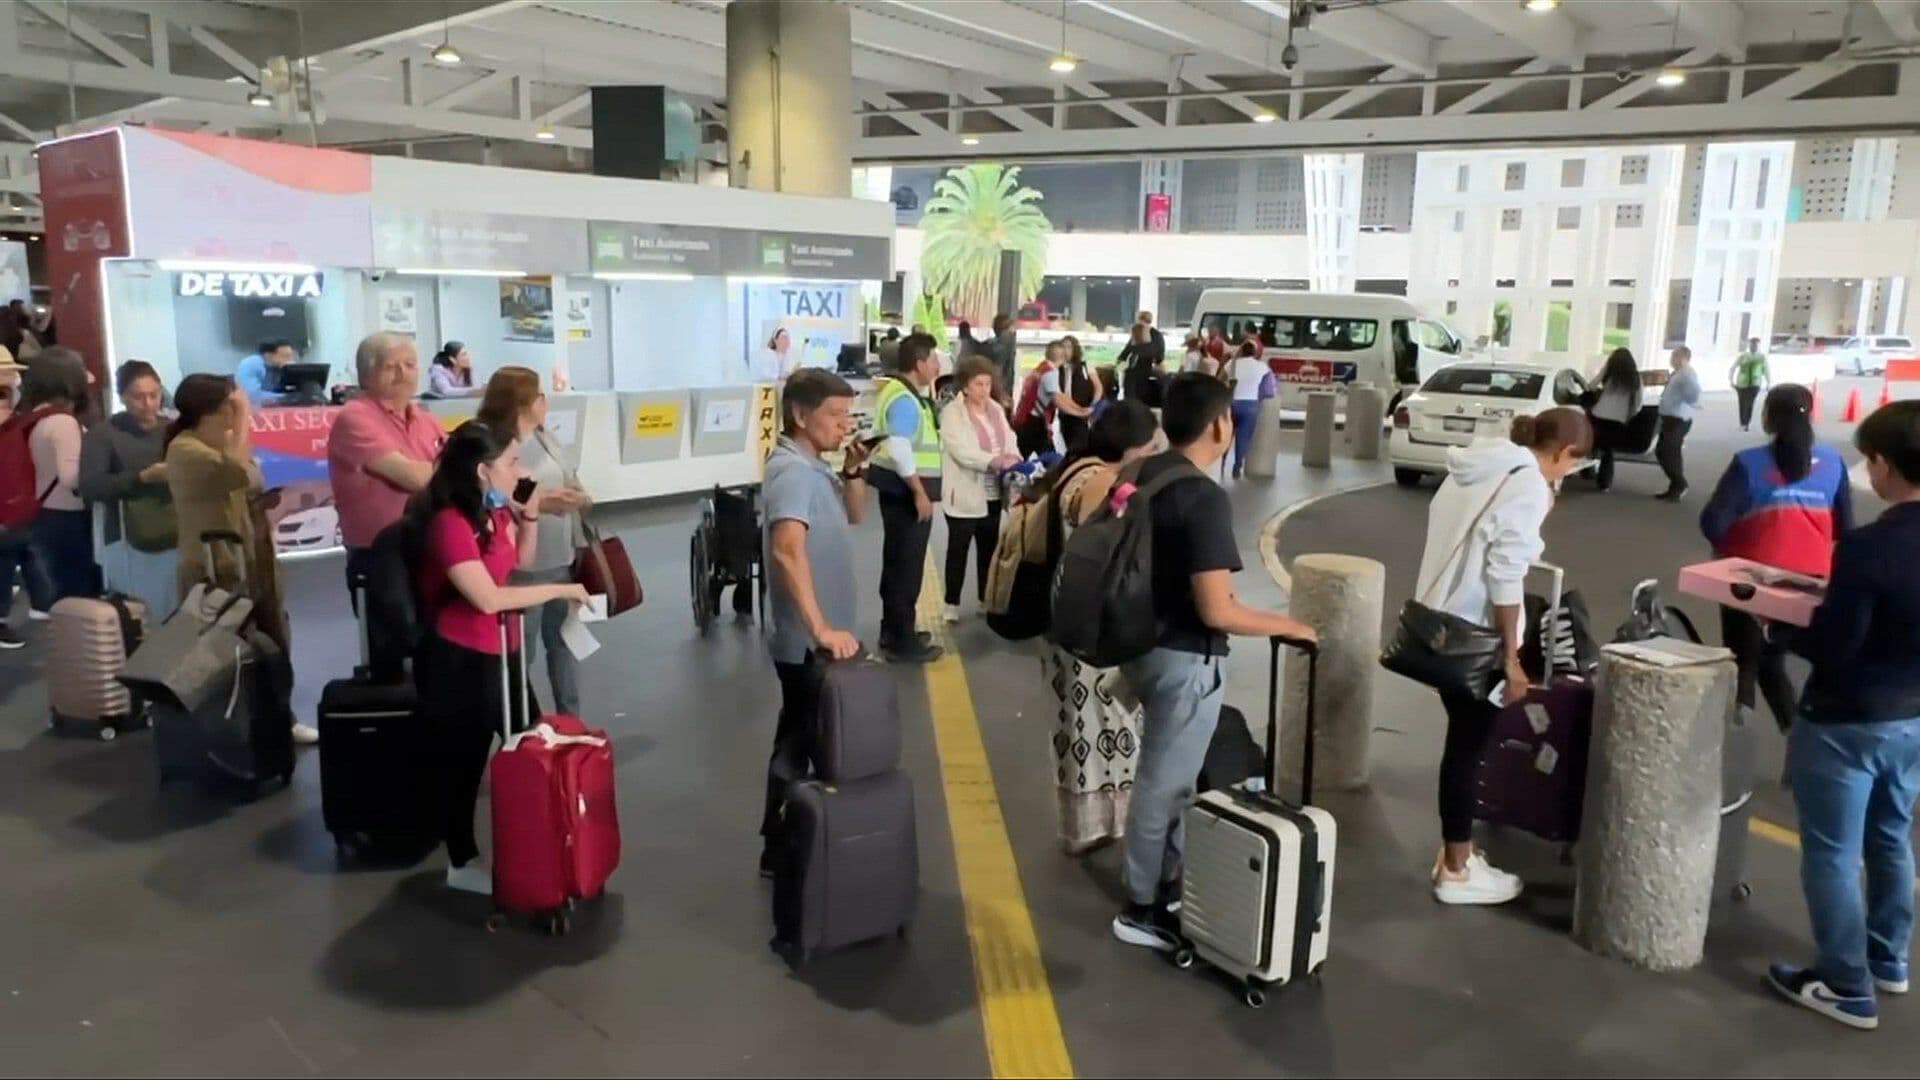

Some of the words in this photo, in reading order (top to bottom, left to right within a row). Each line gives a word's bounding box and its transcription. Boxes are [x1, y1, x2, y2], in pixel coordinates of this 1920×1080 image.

[181, 272, 222, 296] DE
[228, 273, 293, 297] TAXI
[297, 274, 321, 297] A
[781, 289, 842, 318] TAXI
[249, 411, 287, 432] AXI
[294, 408, 337, 430] SEC
[760, 387, 774, 464] TAXI
